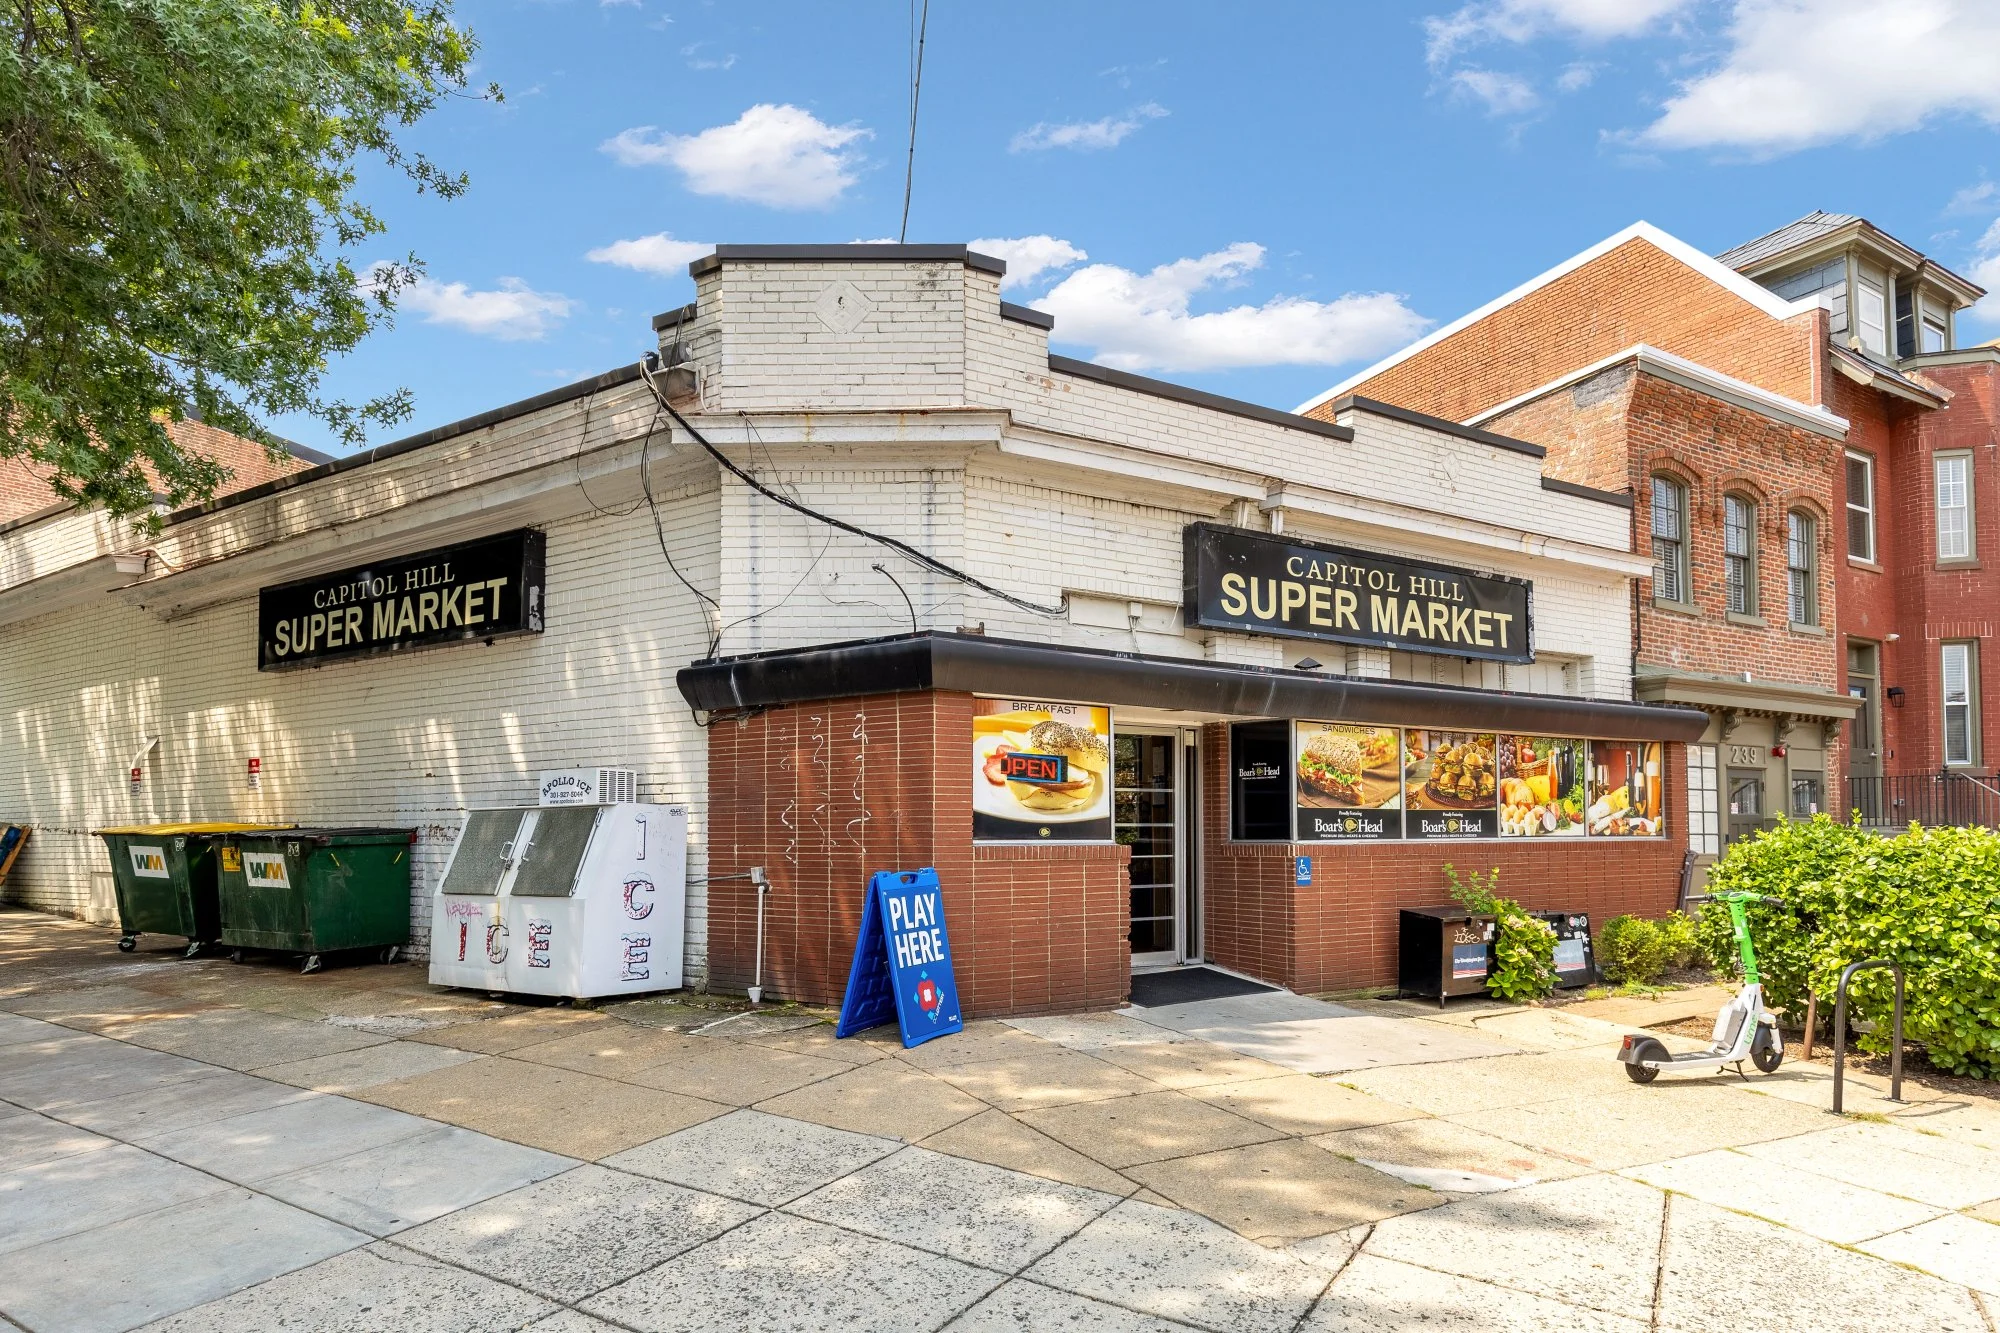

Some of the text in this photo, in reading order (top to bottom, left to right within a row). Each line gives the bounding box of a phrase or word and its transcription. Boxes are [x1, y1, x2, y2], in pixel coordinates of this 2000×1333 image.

[314, 562, 456, 609] CAPITOL HILL
[1287, 556, 1464, 602] CAPITOL HILL
[274, 577, 508, 657] SUPER MARKET
[1221, 572, 1513, 648] SUPER MARKET
[1012, 702, 1078, 715] BREAKFAST
[1321, 724, 1376, 735] SANDWICHES
[1731, 745, 1757, 764] 239
[1263, 765, 1280, 776] Head
[542, 776, 593, 797] APOLLO ICE
[1314, 818, 1384, 833] Boar's Head
[1421, 818, 1482, 833] Boar's Head
[134, 854, 164, 871] WM
[250, 862, 284, 880] WM
[888, 893, 936, 932] PLAY
[458, 914, 552, 968] ICE
[894, 928, 945, 969] HERE
[1743, 1014, 1758, 1045] Lime
